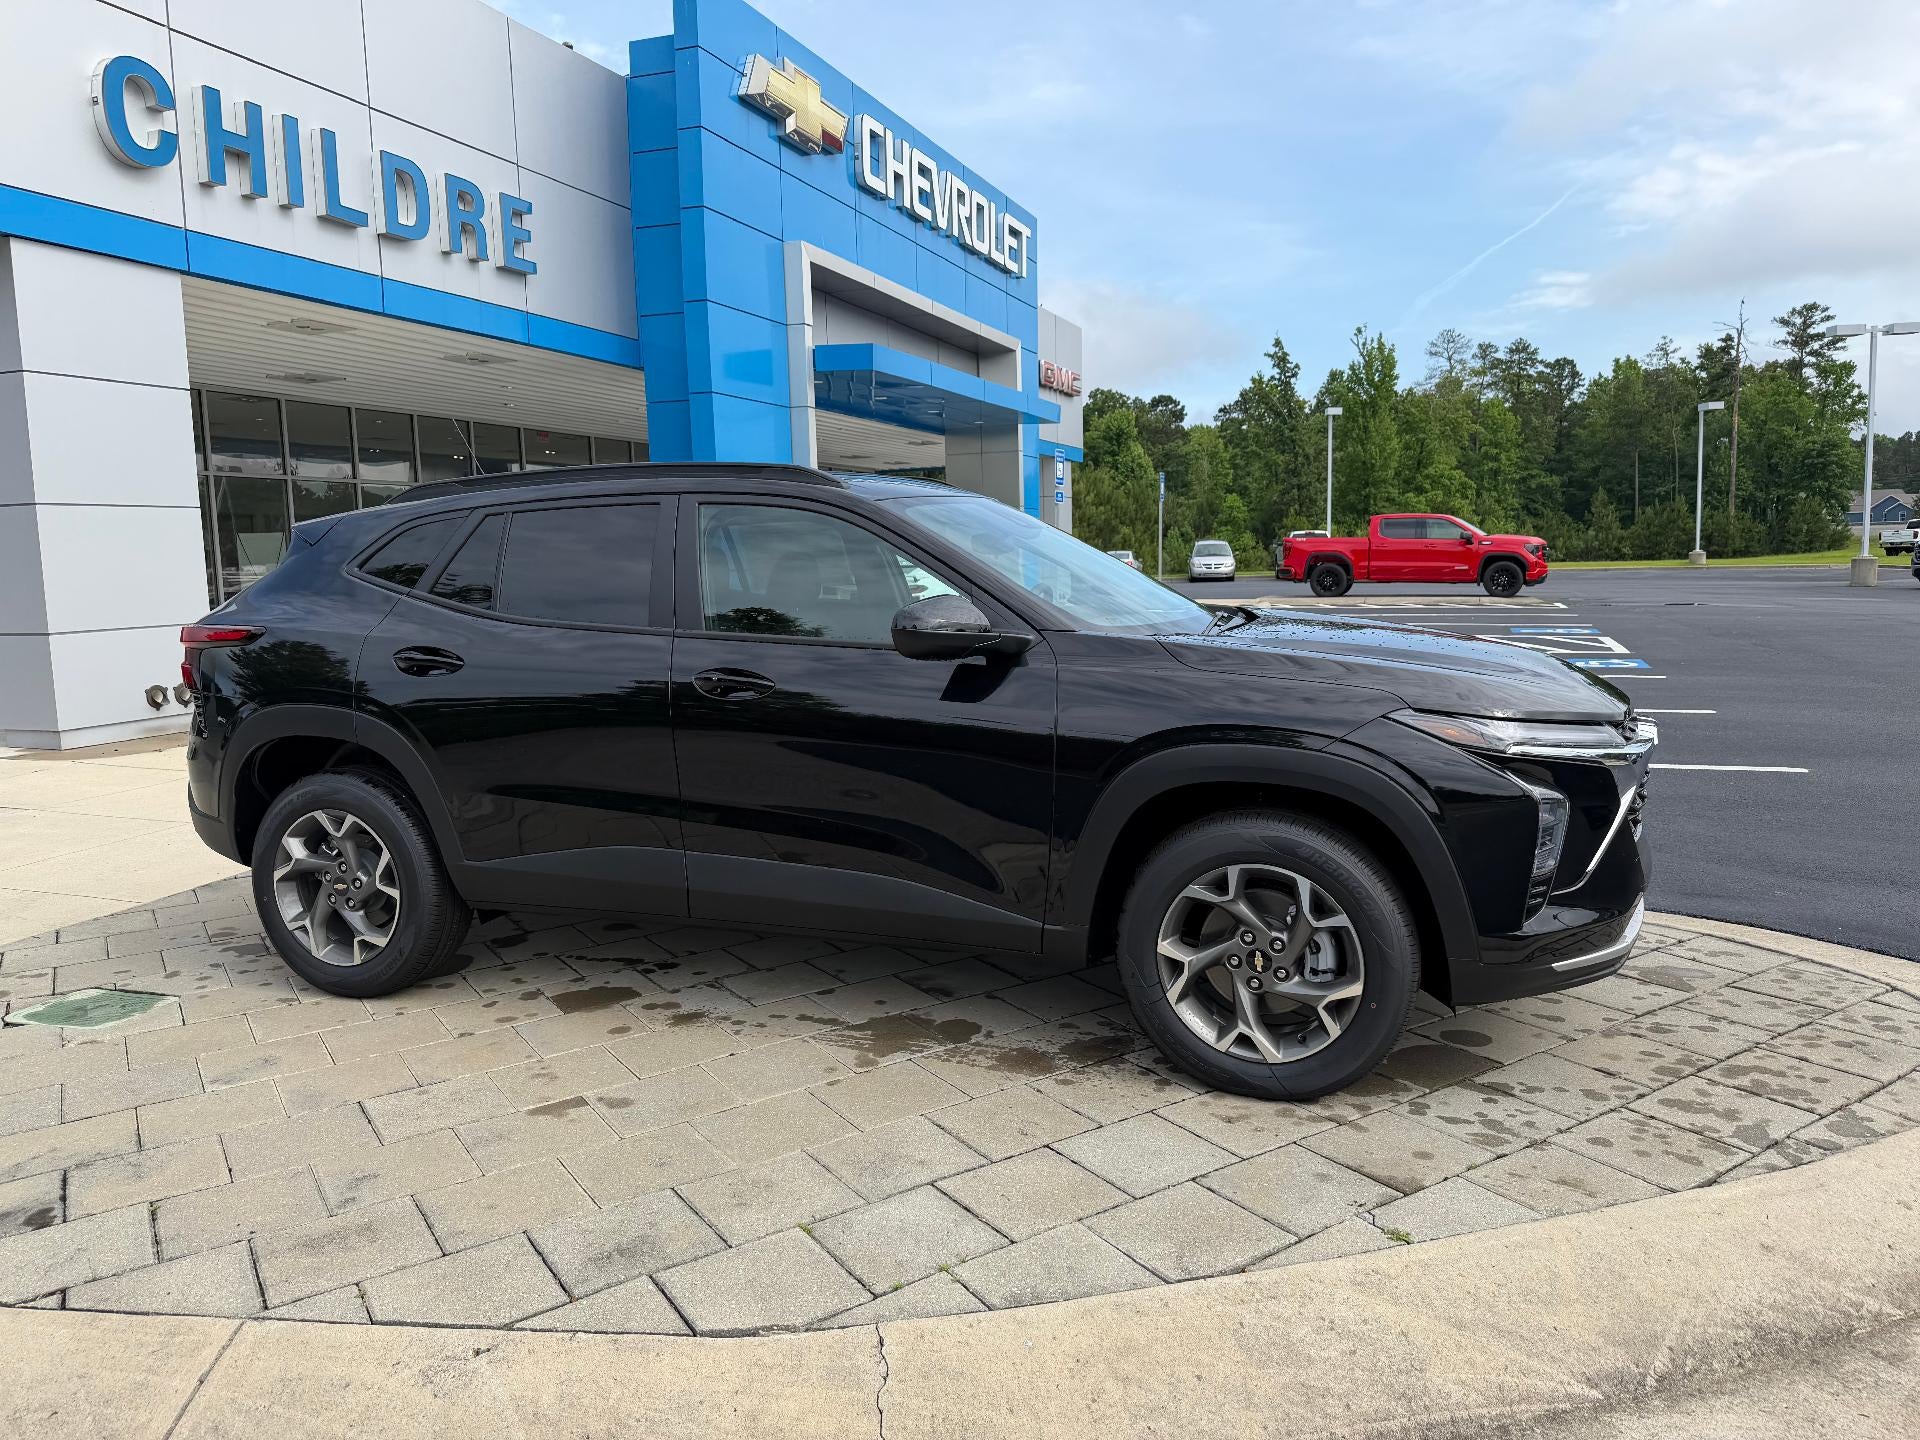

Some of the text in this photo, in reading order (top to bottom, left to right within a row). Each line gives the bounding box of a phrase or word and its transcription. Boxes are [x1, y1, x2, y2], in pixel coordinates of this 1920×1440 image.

[93, 55, 537, 275] CHILDRE
[855, 113, 1031, 279] CHEVROLET
[1040, 360, 1082, 397] GMC
